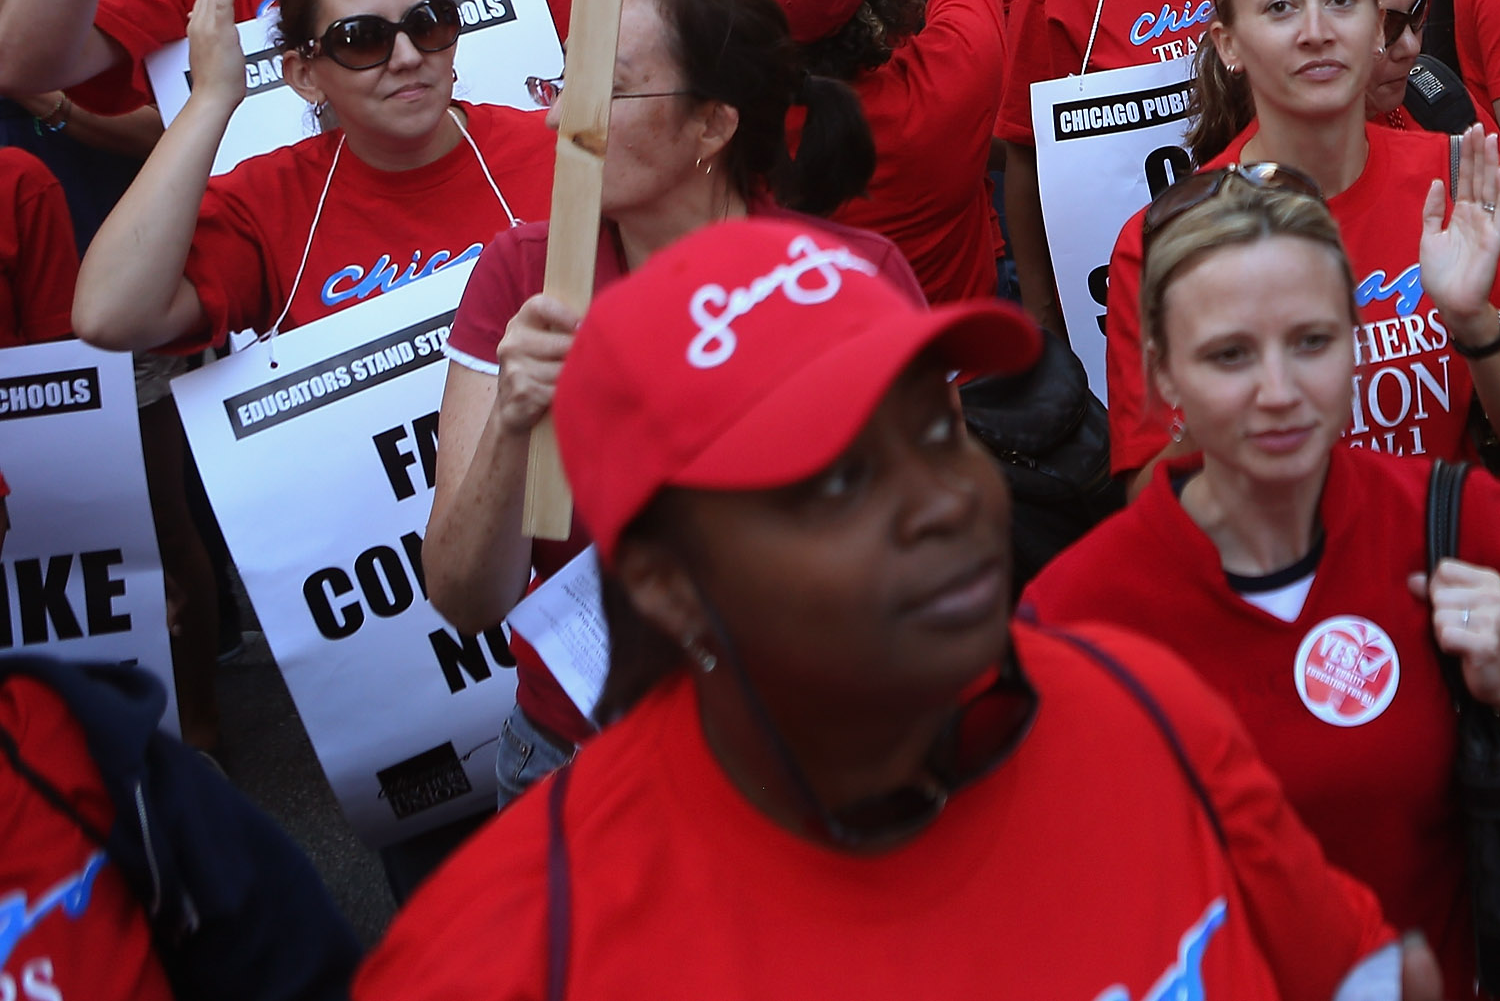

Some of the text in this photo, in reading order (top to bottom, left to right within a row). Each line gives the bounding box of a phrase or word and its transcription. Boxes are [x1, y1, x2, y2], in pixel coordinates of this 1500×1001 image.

[1059, 100, 1140, 135] CHICAGO
[236, 337, 416, 427] EDUCATORS STAND
[1319, 633, 1360, 670] YES
[1324, 662, 1336, 673] TO
